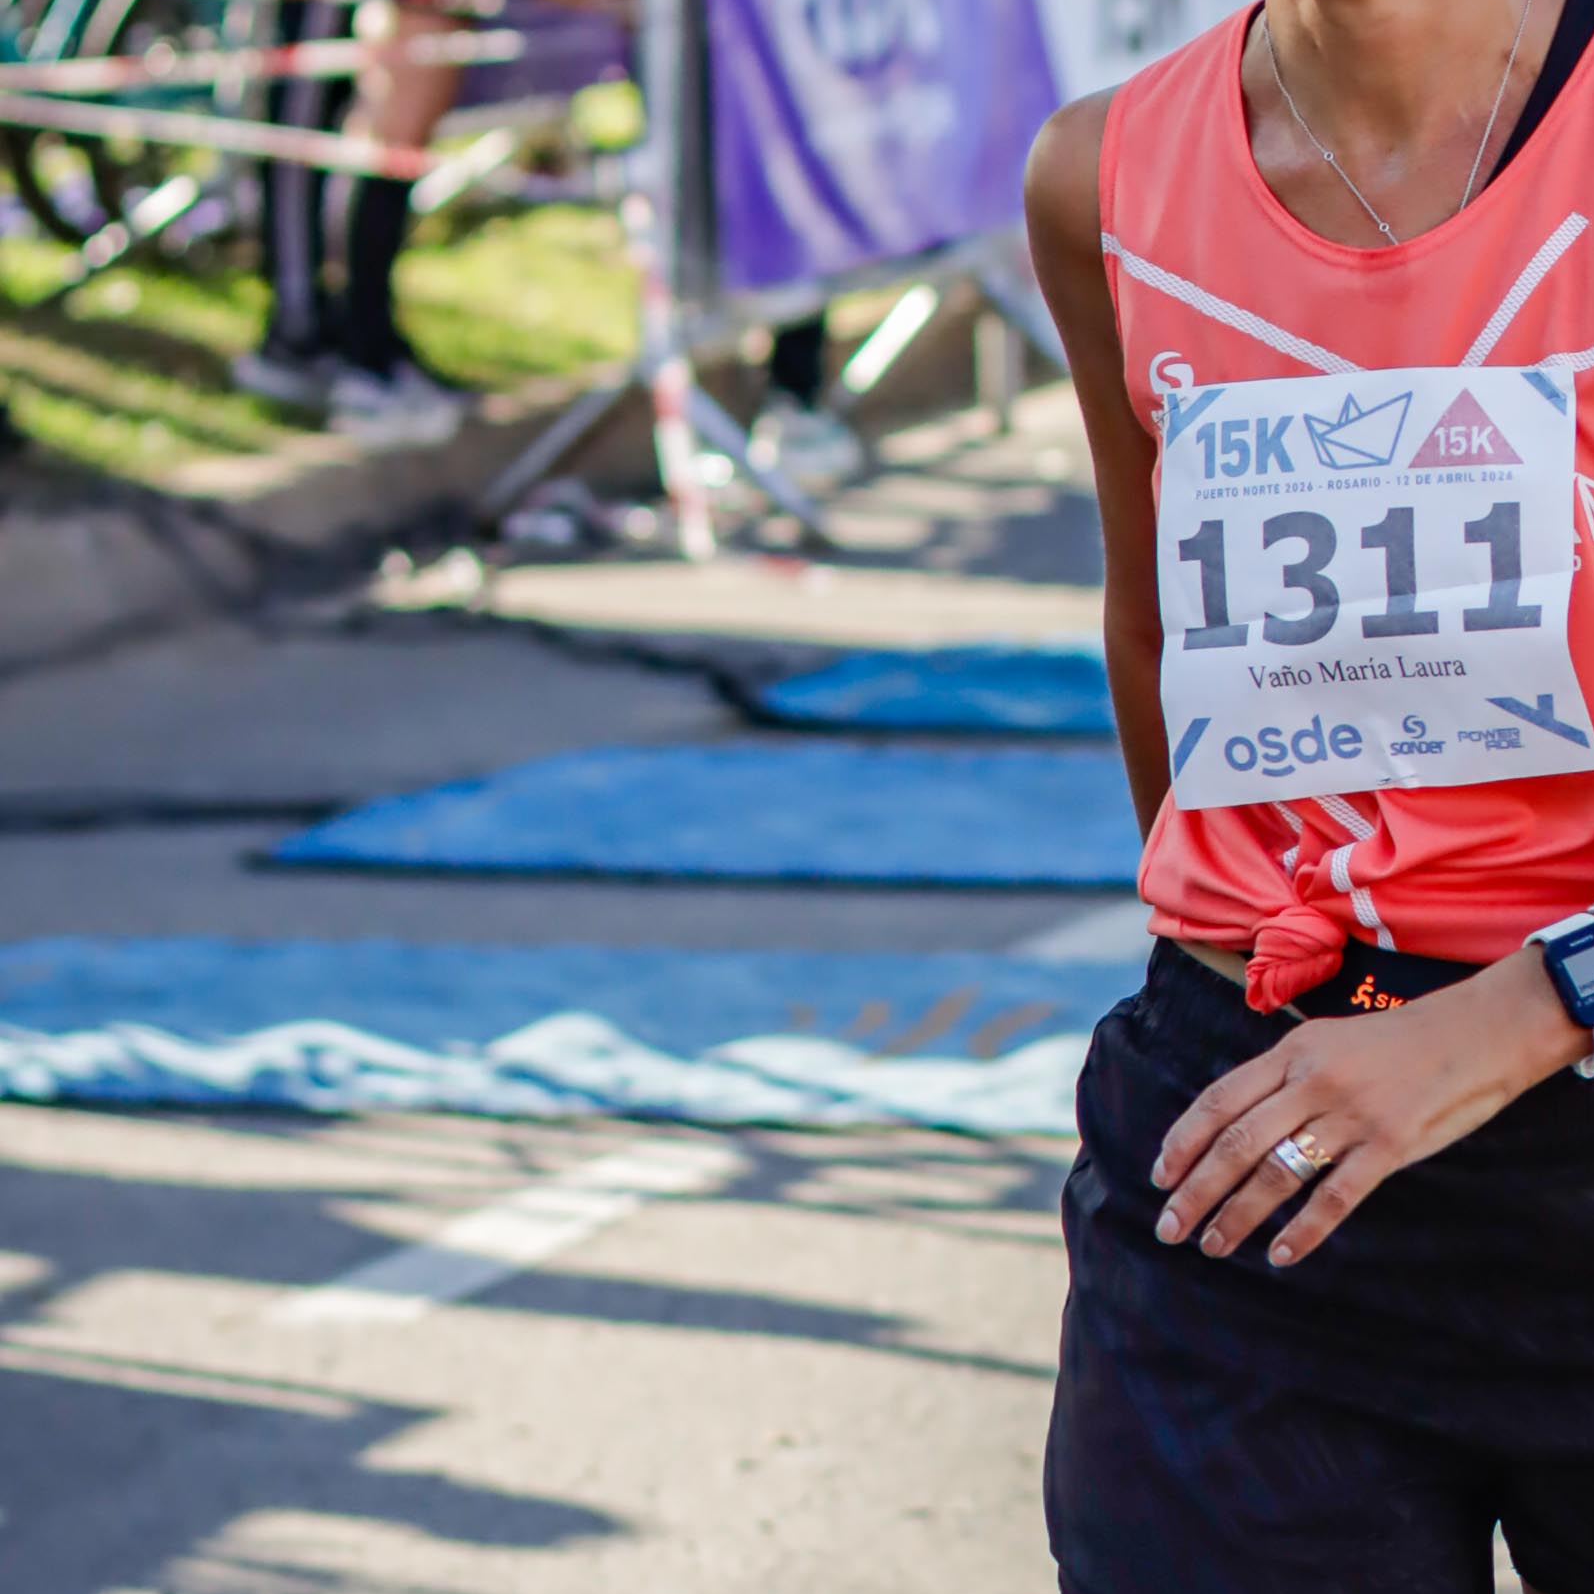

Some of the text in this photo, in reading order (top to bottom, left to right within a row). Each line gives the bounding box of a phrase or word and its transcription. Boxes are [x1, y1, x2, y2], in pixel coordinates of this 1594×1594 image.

[1195, 415, 1295, 479] 15K
[1434, 425, 1495, 457] 15K
[1196, 487, 1239, 500] PUERTO
[1243, 484, 1280, 496] NORTE
[1285, 482, 1313, 493] 2026
[1327, 475, 1381, 490] ROSARIO
[1416, 474, 1431, 485] DE
[1437, 471, 1475, 483] ABRIL
[1178, 502, 1541, 650] 1311
[1248, 656, 1467, 690] Vaño María Laura
[1224, 714, 1362, 776] osde
